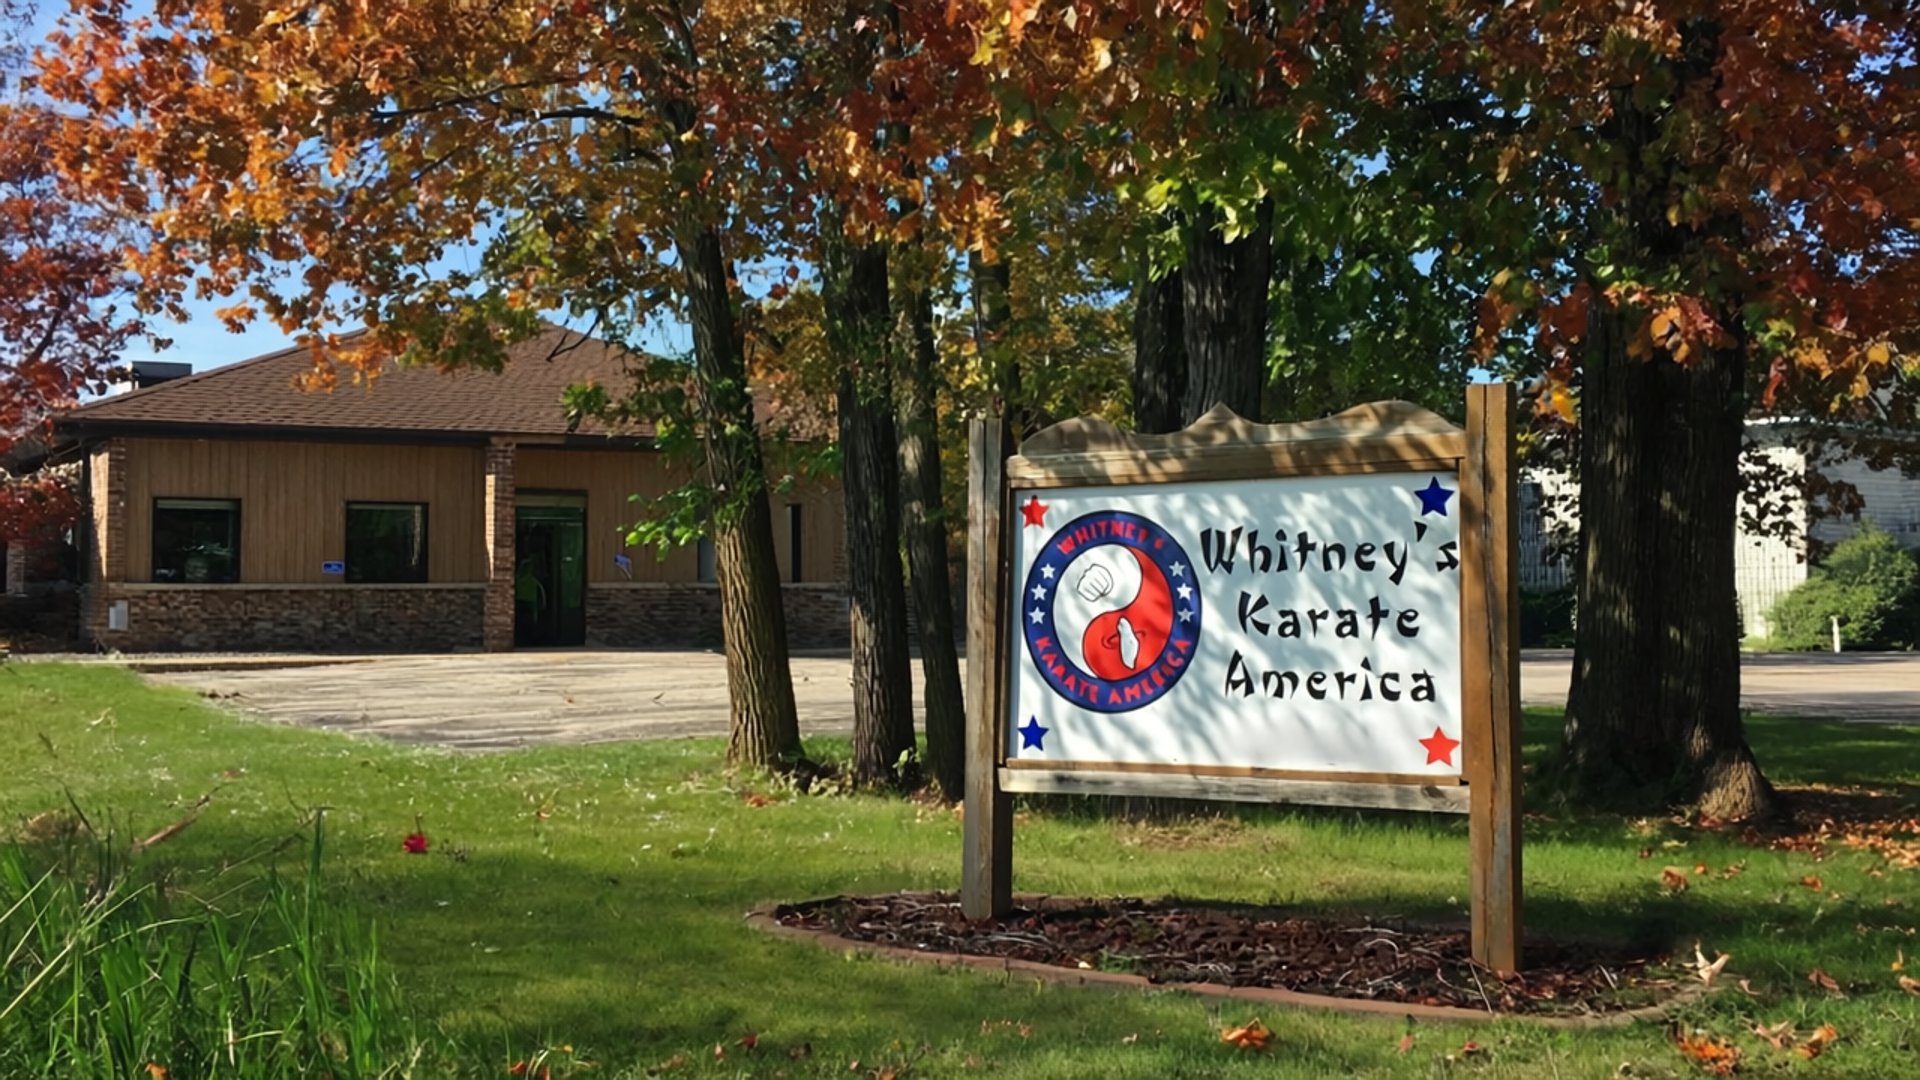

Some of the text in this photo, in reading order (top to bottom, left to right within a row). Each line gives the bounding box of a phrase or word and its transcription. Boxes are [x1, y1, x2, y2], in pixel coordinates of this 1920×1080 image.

[1056, 521, 1165, 555] WHITNE
[1199, 521, 1459, 586] Whitney's
[1238, 591, 1420, 639] Karate
[1226, 650, 1436, 702] America
